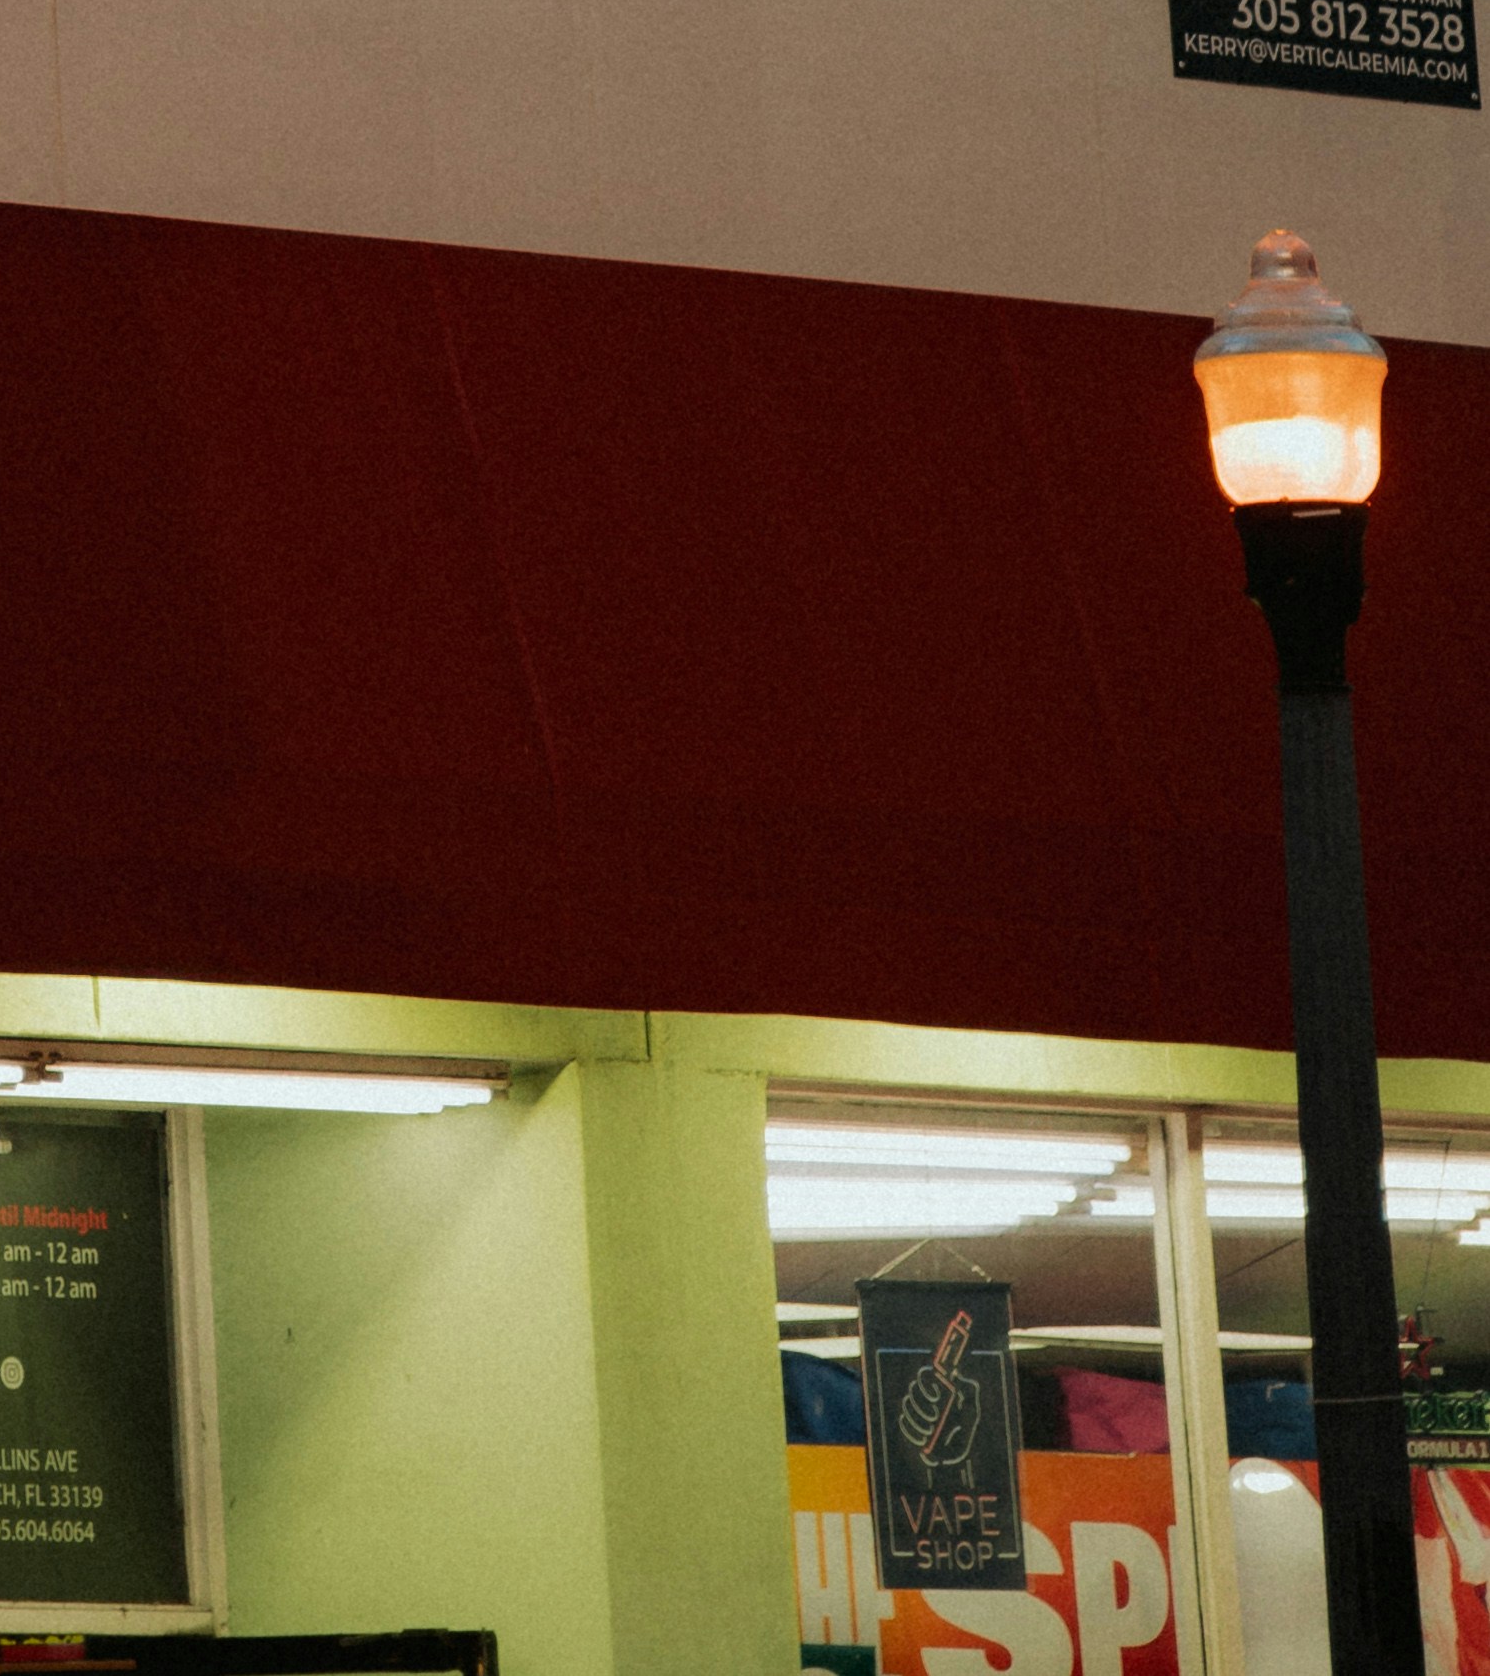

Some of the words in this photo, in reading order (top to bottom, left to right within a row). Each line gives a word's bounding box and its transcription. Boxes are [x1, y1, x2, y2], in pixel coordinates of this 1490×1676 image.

[1311, 0, 1369, 42] 812
[1378, 6, 1465, 53] 3528
[1184, 32, 1468, 83] KERRY@VERTICALREMIA.COM
[23, 1204, 108, 1236] Midnight
[3, 1244, 31, 1262] am
[47, 1242, 67, 1264] 12
[71, 1245, 99, 1265] am
[1, 1278, 29, 1297] am
[45, 1276, 65, 1298] 12
[70, 1280, 97, 1299] am
[44, 1449, 78, 1473] AVE
[1407, 1440, 1478, 1459] ORMULA
[24, 1484, 46, 1507] FL
[49, 1485, 104, 1508] 33139
[900, 1494, 1000, 1537] VAPE
[917, 1540, 994, 1570] SHOP
